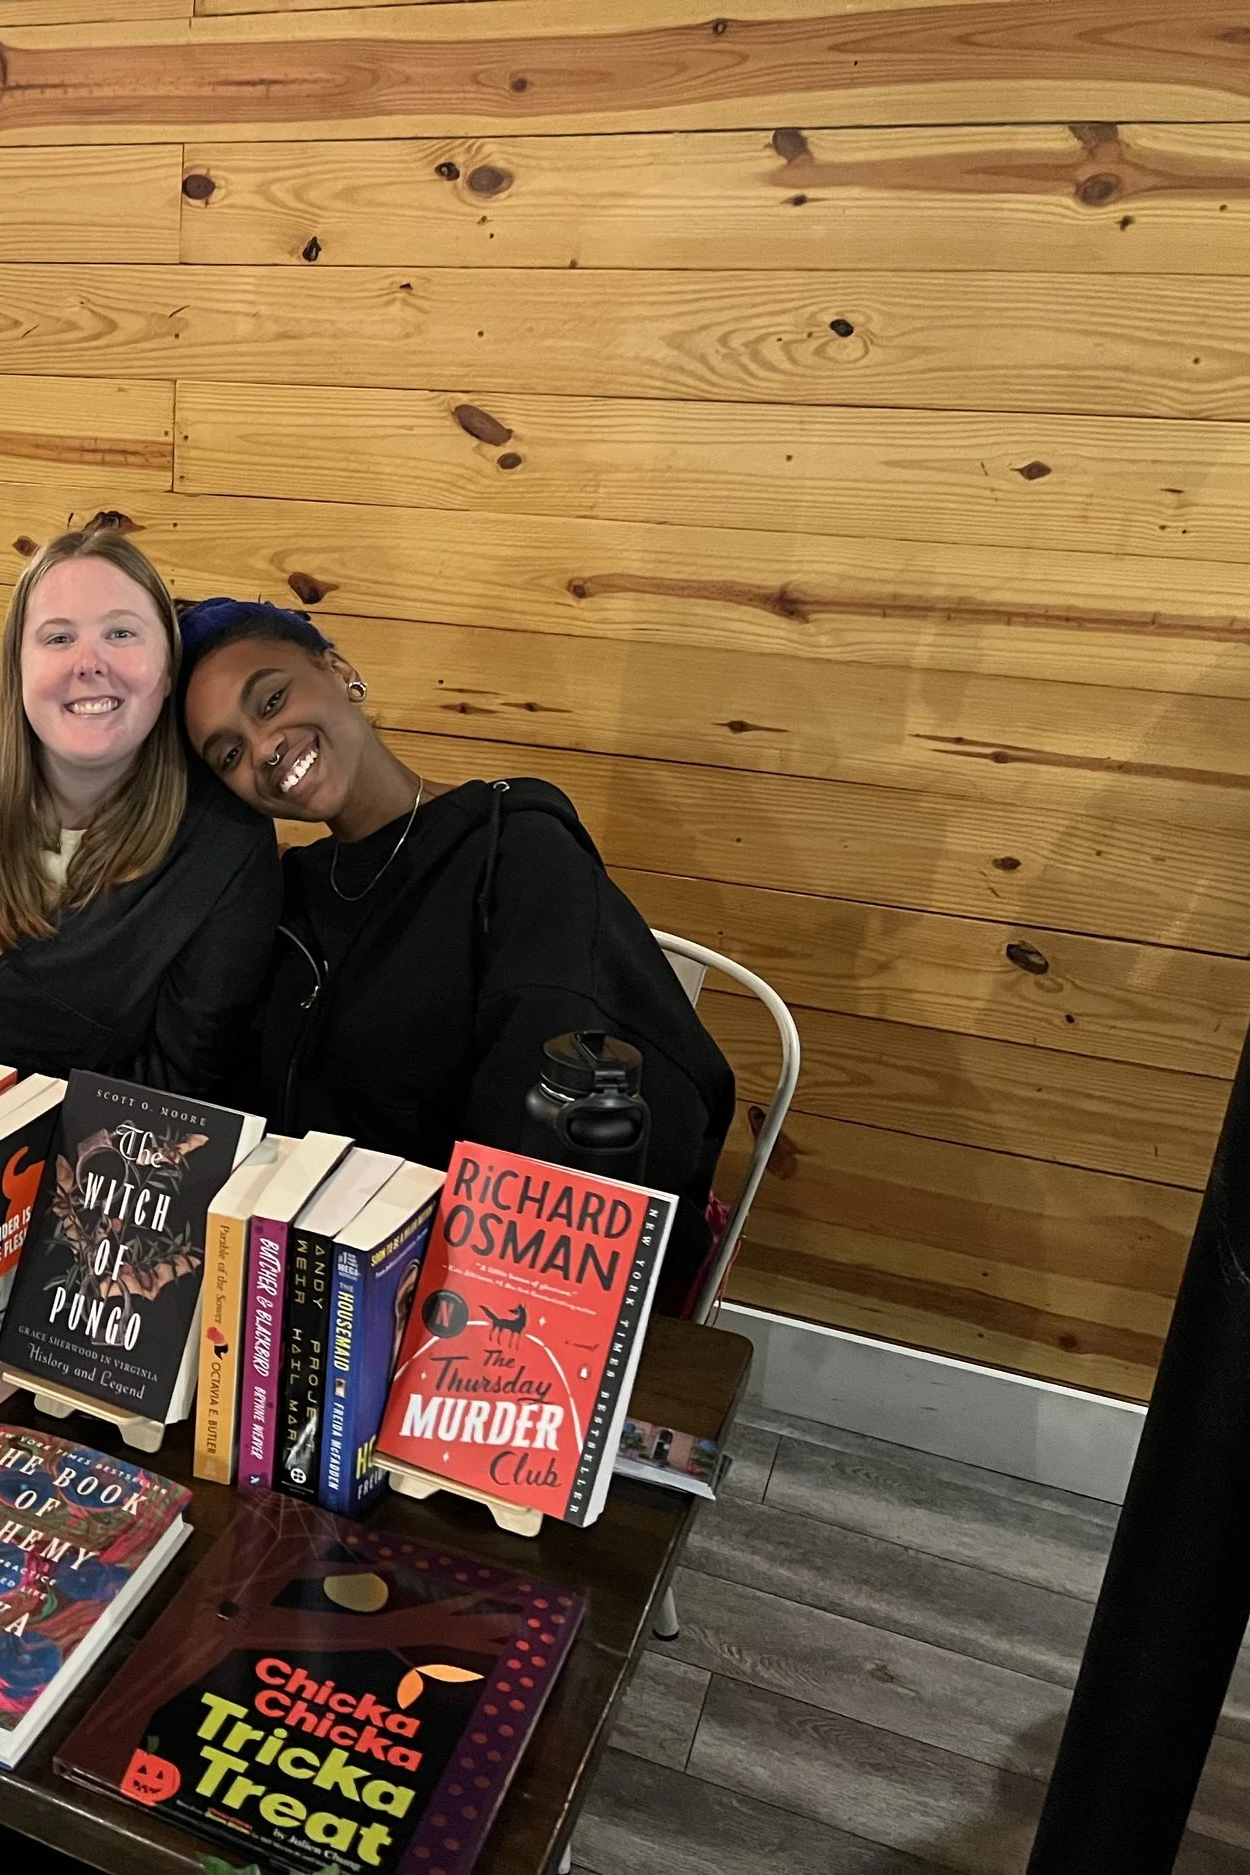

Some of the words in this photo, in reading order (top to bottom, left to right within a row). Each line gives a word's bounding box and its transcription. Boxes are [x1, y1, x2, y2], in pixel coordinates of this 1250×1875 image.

[96, 1089, 135, 1108] SCOTT
[160, 1106, 208, 1127] MOORE
[115, 1121, 165, 1169] The
[22, 1205, 31, 1225] IS
[83, 1172, 171, 1233] WITCH
[218, 1225, 230, 1260] Parable
[443, 1203, 622, 1292] OSMAN
[640, 1208, 658, 1247] NEW
[94, 1237, 130, 1281] OF
[218, 1274, 228, 1292] the
[219, 1262, 228, 1274] of
[256, 1237, 280, 1295] BUTCHER
[294, 1239, 307, 1304] WEIR
[312, 1245, 325, 1310] ANDY
[625, 1258, 646, 1306] YORK
[215, 1293, 226, 1324] Sower
[255, 1296, 272, 1310] &
[339, 1281, 354, 1292] THE
[49, 1286, 142, 1351] PUNGO
[334, 1290, 354, 1372] HOUSEMAID
[18, 1325, 47, 1343] GRACE
[48, 1336, 99, 1361] SHERWOOD
[100, 1353, 111, 1364] IN
[114, 1358, 159, 1383] VIRGINIA
[252, 1308, 273, 1378] BLACKBIRD
[289, 1328, 302, 1386] HAIL
[483, 1349, 516, 1369] The
[606, 1318, 629, 1379] TIMES
[28, 1342, 70, 1376] History
[74, 1364, 95, 1383] and
[99, 1370, 146, 1401] Legend
[210, 1363, 222, 1408] OCTAVIA
[430, 1354, 552, 1402] Thursday
[253, 1386, 267, 1424] BRYNNE
[330, 1402, 345, 1437] FREIDA
[399, 1394, 564, 1452] MURDER
[206, 1420, 218, 1454] BUTLER
[250, 1423, 264, 1460] WEAVER
[569, 1390, 610, 1514] BESTSELLER
[21, 1436, 51, 1451] YORK
[56, 1448, 91, 1466] TIMES
[96, 1463, 168, 1495] BESTSELLER
[489, 1450, 562, 1488] Club
[14, 1490, 61, 1517] OF
[52, 1467, 148, 1515] BOOK
[20, 1586, 48, 1600] LIFE
[254, 1656, 421, 1739] Chicka
[254, 1689, 424, 1773] Chicka
[196, 1692, 416, 1819] Tricka
[195, 1744, 394, 1868] Treat
